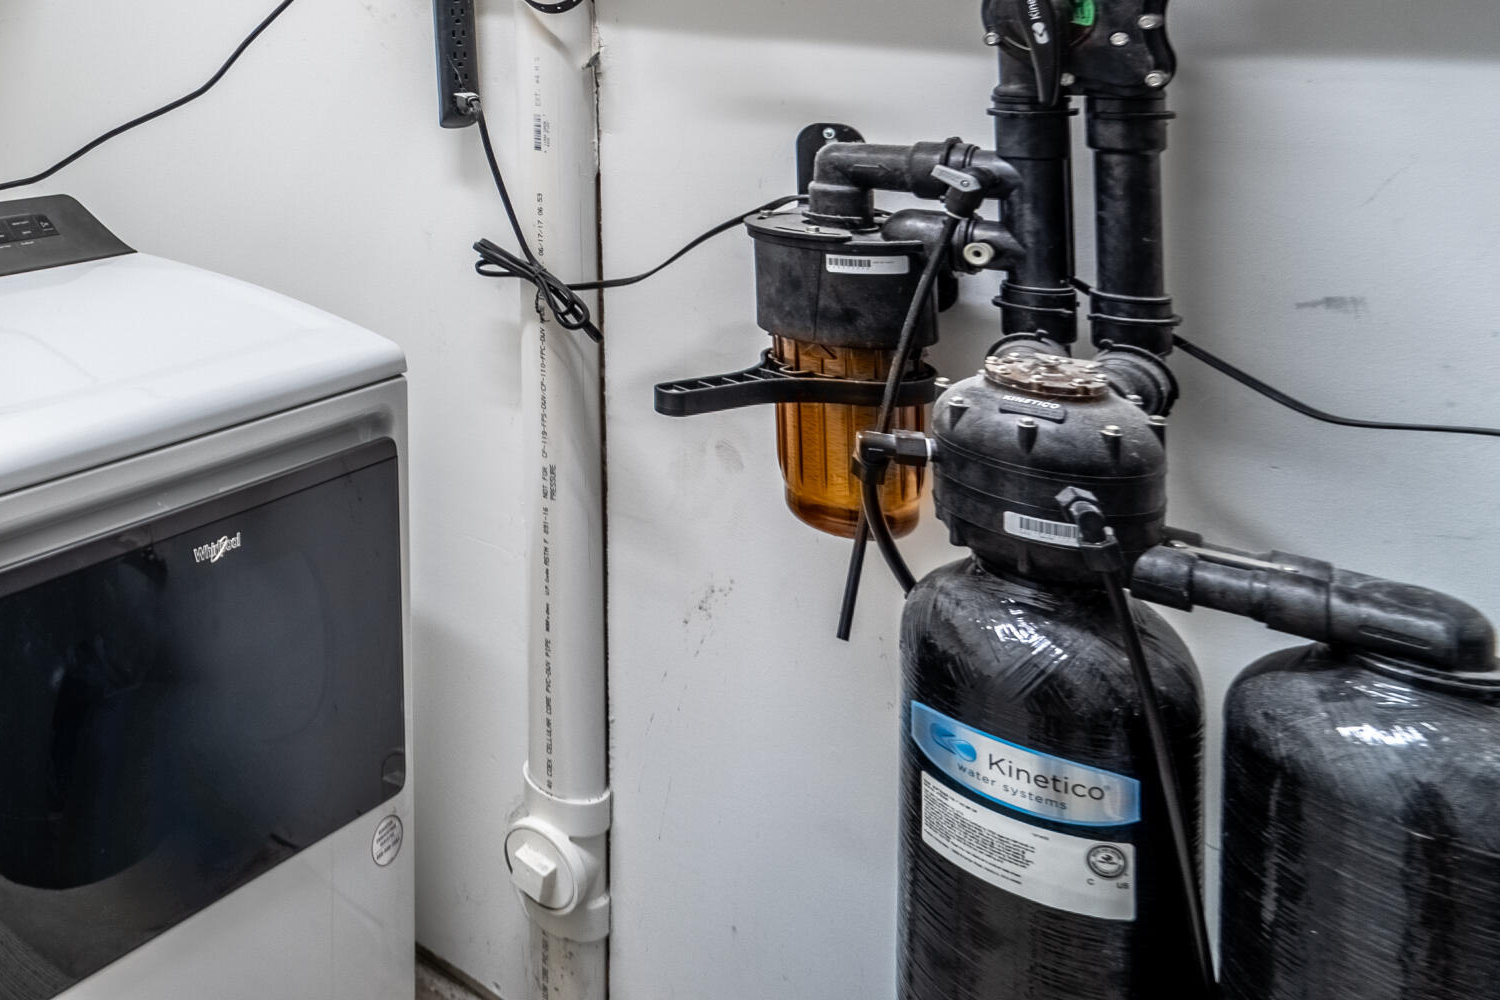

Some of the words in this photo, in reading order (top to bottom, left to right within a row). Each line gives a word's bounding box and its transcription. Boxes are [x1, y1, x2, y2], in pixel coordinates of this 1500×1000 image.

[1001, 394, 1061, 409] KINETICO
[193, 531, 241, 563] Whirlpool
[957, 763, 997, 786] water
[1002, 784, 1069, 811] systems
[988, 753, 1106, 801] Kinetico
